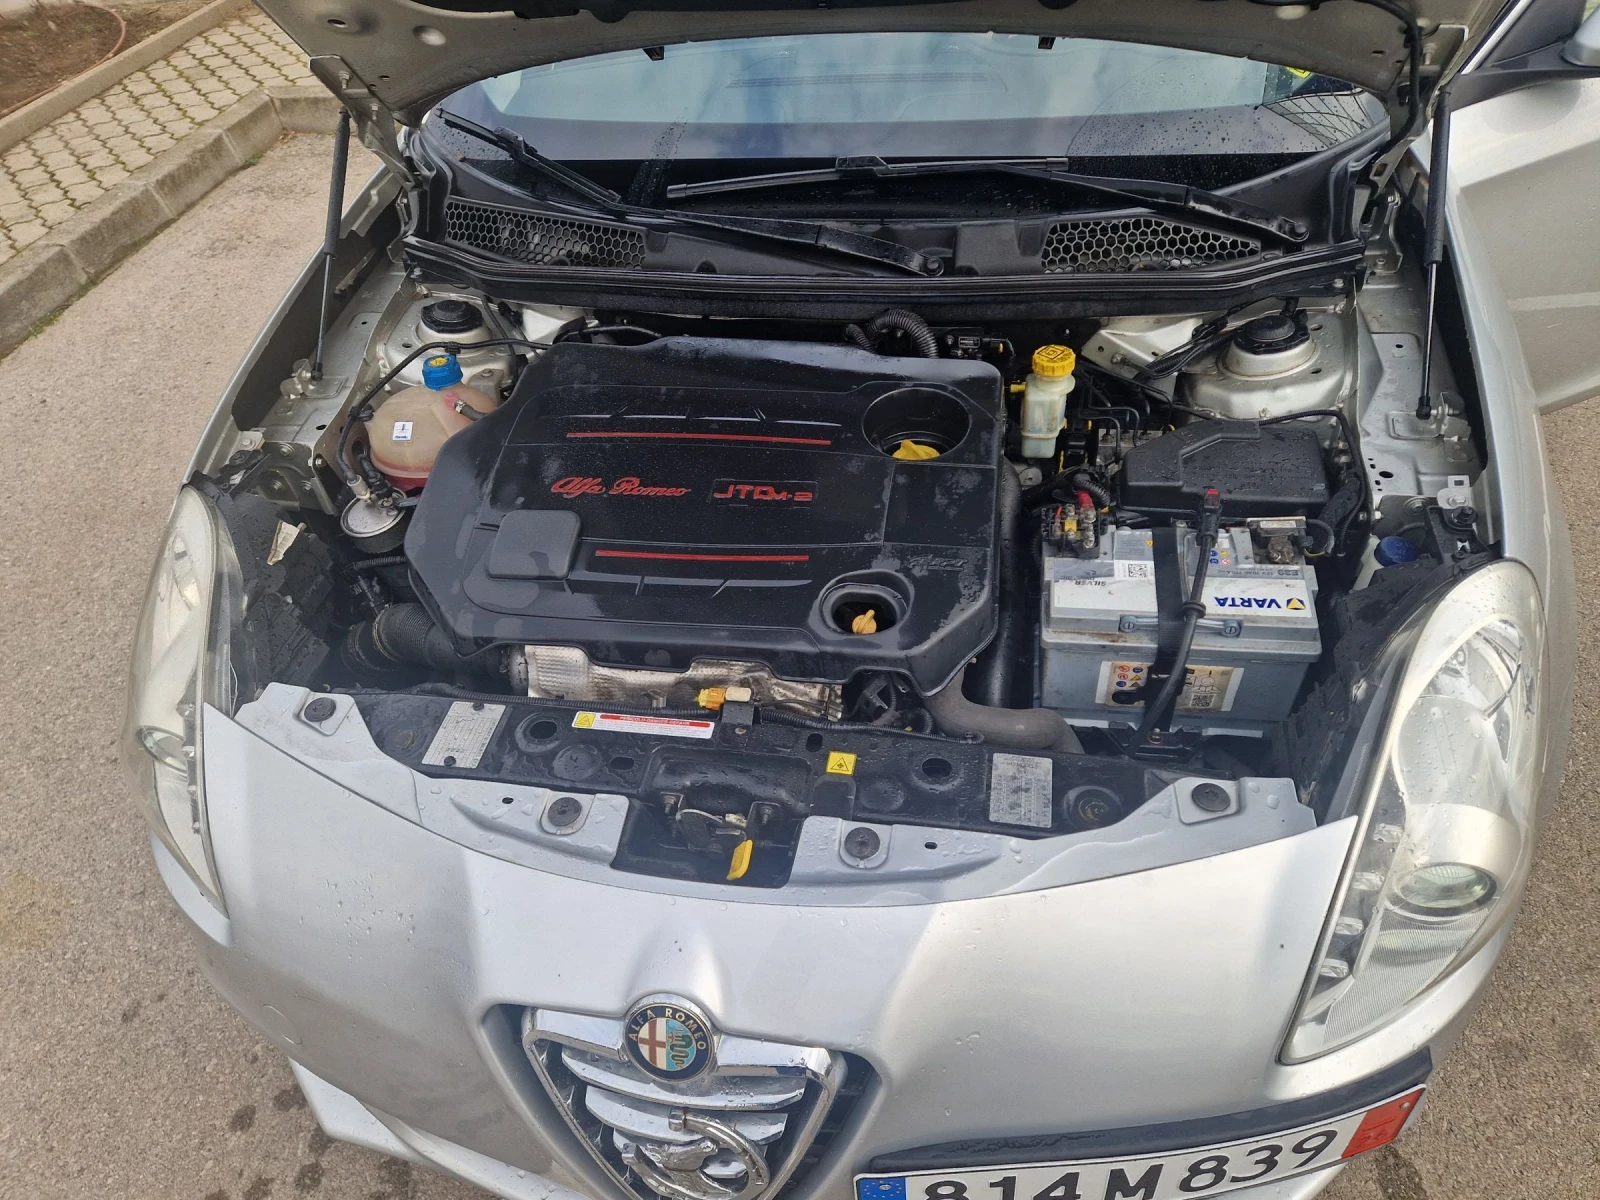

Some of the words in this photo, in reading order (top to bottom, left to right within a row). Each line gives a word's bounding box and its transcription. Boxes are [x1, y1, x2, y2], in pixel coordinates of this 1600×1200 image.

[551, 477, 605, 499] Alfa
[608, 477, 692, 497] Romeo
[1075, 580, 1107, 588] SILVER
[1215, 596, 1282, 610] VARTA
[629, 1009, 656, 1042] ALFA
[665, 1008, 707, 1050] ROMEO
[1178, 1130, 1338, 1193] 839
